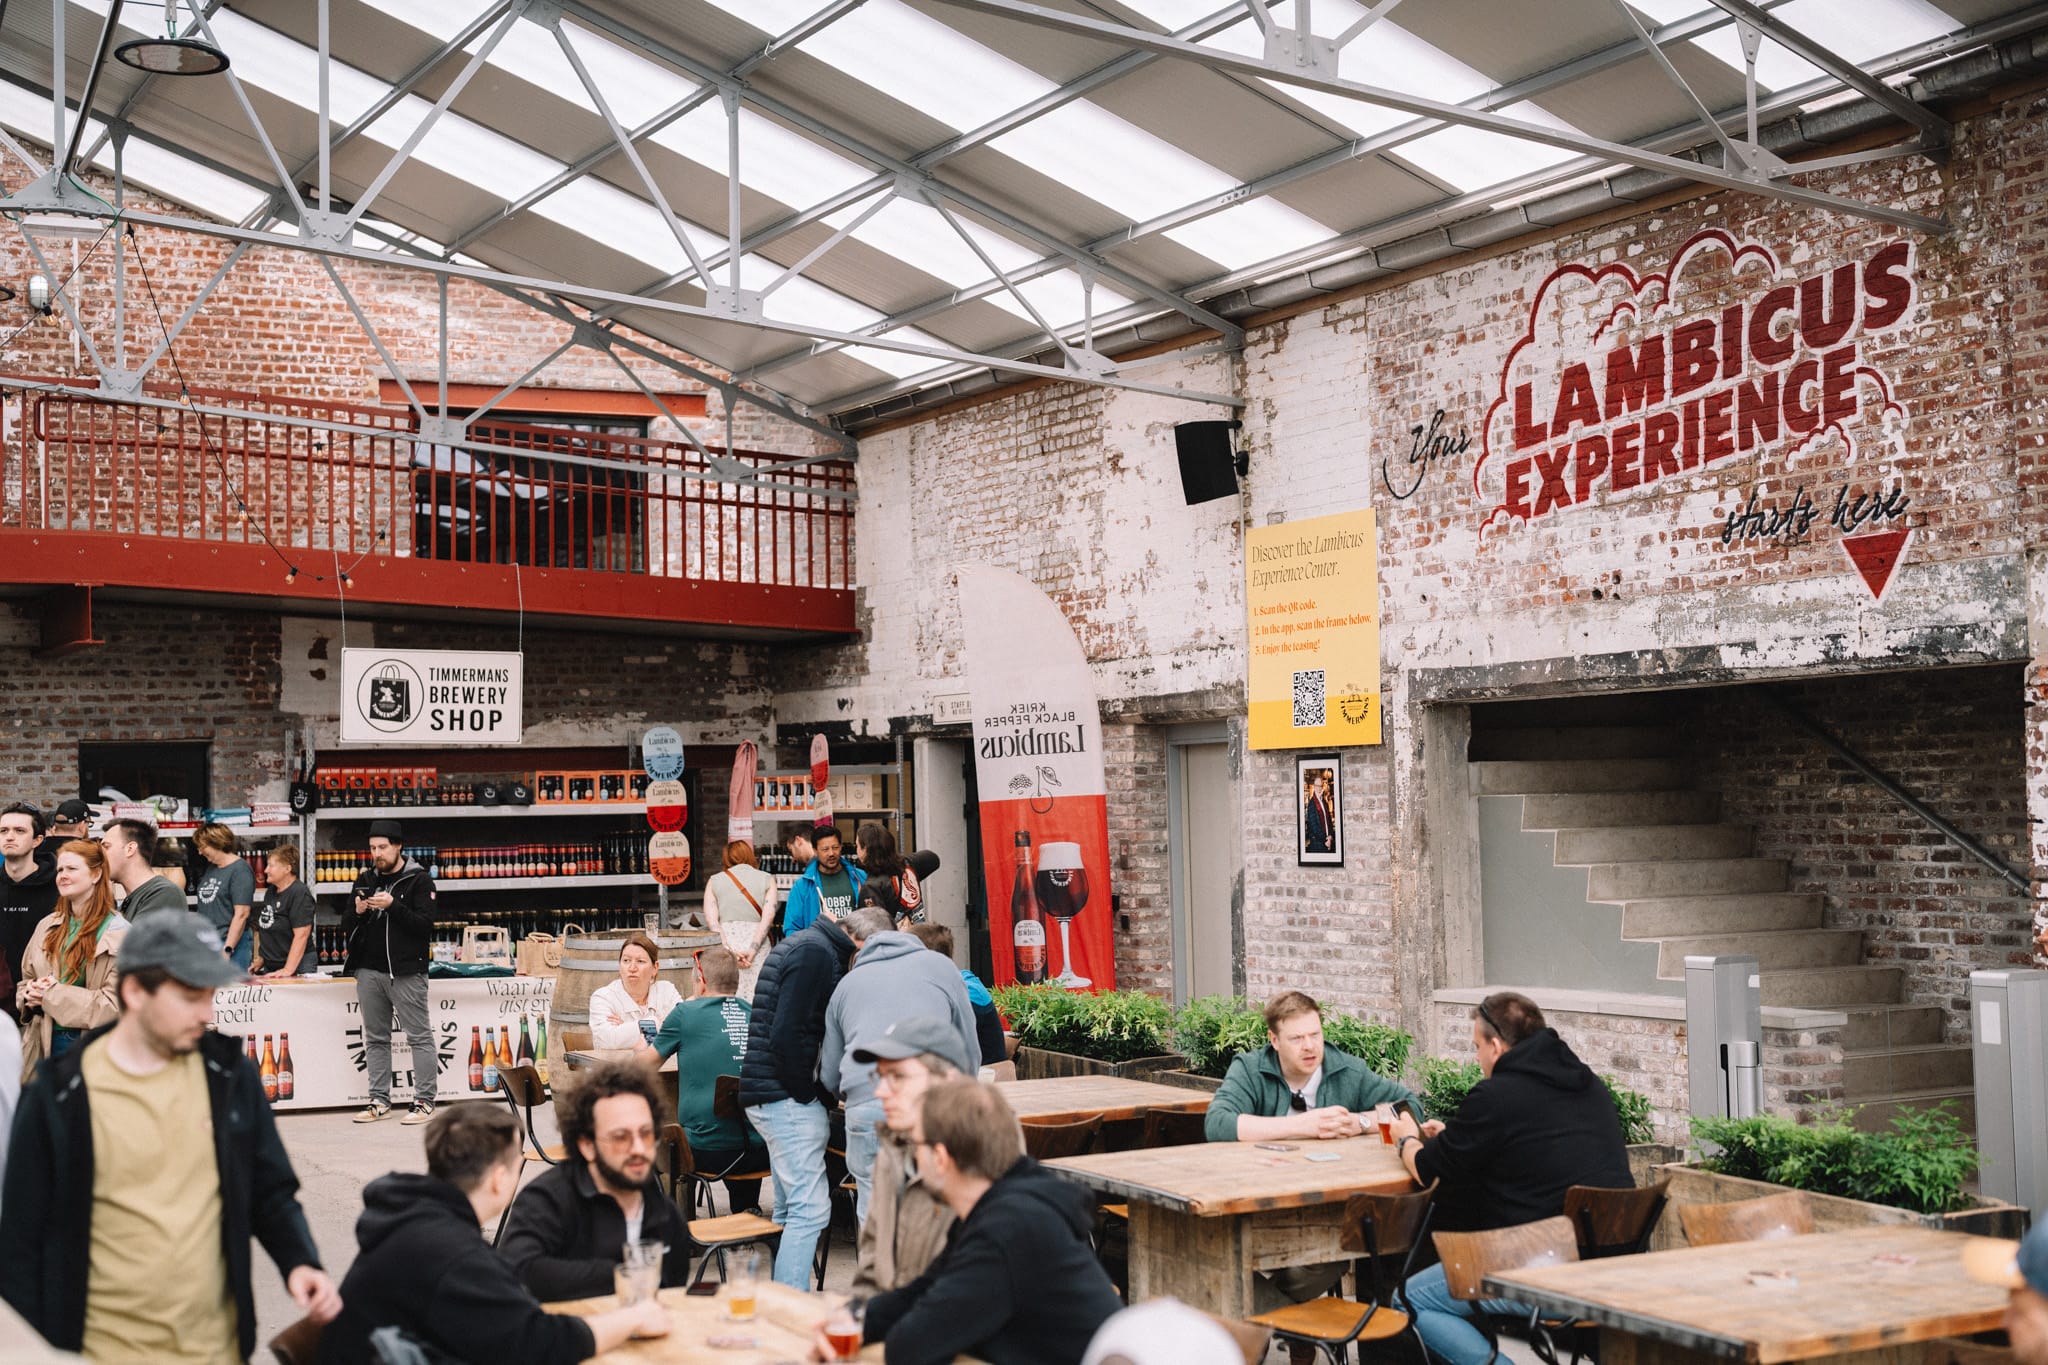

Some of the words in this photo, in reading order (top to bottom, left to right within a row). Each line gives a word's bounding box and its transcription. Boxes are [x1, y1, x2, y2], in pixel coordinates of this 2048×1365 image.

[1514, 241, 1911, 450] LAMBICUS
[1505, 345, 1861, 513] EXPERIENCE
[1383, 408, 1472, 500] Your
[1721, 486, 1819, 543] starts
[1832, 485, 1911, 533] here
[1252, 544, 1294, 563] Discover
[1296, 537, 1313, 556] the
[1314, 530, 1364, 554] Lambicus
[1252, 565, 1304, 591] Experience
[1305, 561, 1340, 580] Center.
[1260, 606, 1276, 615] Scan
[1276, 603, 1287, 614] the
[1288, 601, 1298, 614] QR
[1262, 625, 1268, 635] In
[1269, 624, 1280, 634] the
[1296, 621, 1313, 631] scan
[1314, 618, 1325, 629] the
[1326, 616, 1347, 628] frame
[1262, 644, 1280, 656] Enjoy
[1281, 643, 1291, 653] the
[429, 667, 509, 683] TIMMERMANS
[430, 686, 507, 705] BREWERY
[430, 709, 503, 731] SHOP
[228, 985, 272, 1004] wilde
[486, 980, 529, 997] Waar
[533, 977, 552, 995] de
[206, 1004, 255, 1025] roeit
[346, 1002, 359, 1013] 17
[440, 999, 456, 1010] 02
[499, 996, 527, 1018] gist
